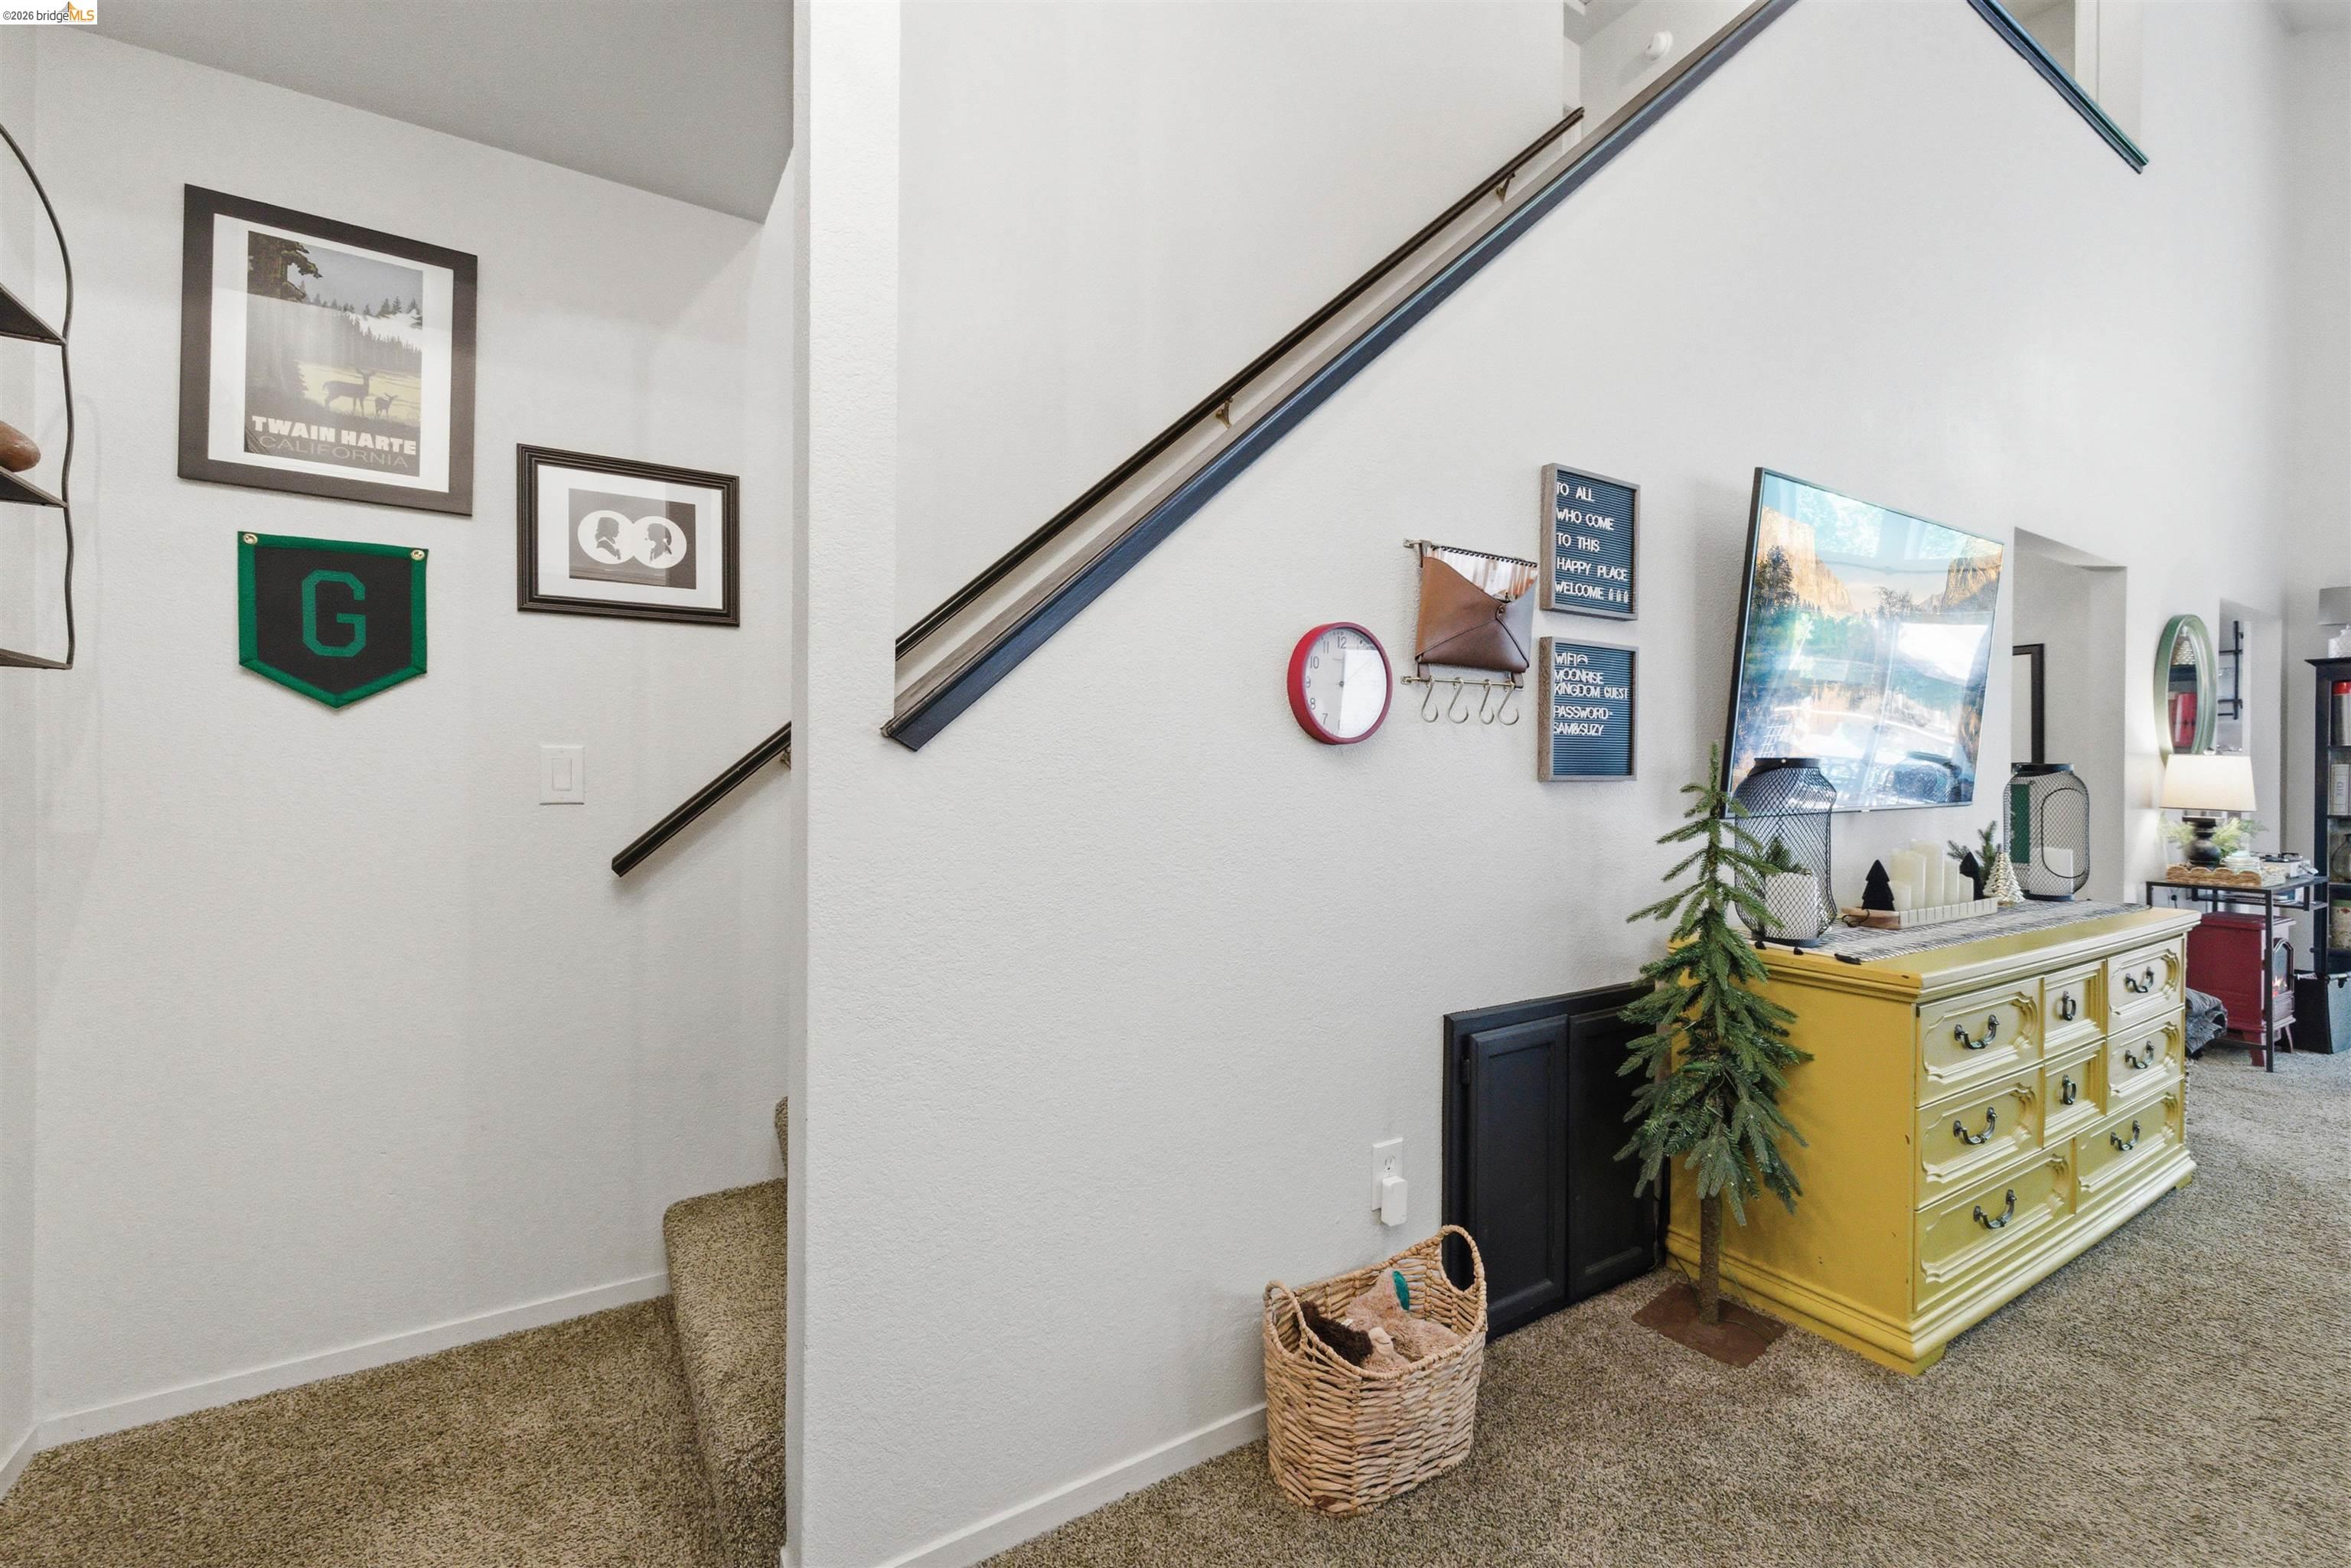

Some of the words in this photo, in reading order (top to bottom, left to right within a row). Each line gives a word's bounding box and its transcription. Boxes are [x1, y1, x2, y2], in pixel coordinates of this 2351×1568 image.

[252, 416, 336, 442] TWAIN
[341, 429, 416, 455] HARTE
[258, 435, 408, 468] CALIFORNIA
[1556, 482, 1569, 496] TO
[1576, 487, 1596, 501] ALL
[1556, 507, 1582, 523] WHO
[1586, 513, 1615, 530] COME
[1556, 533, 1571, 548] TO
[1577, 536, 1600, 553] THIS
[1557, 557, 1592, 575] HAPPY
[1597, 565, 1629, 582] PLACE
[1555, 581, 1604, 600] WELCOME
[302, 569, 367, 657] G
[1322, 641, 1329, 654] 11
[1337, 636, 1347, 649] 12
[1310, 656, 1319, 669] 10
[1554, 668, 1604, 685] MOONRISE
[1554, 682, 1600, 698] KINGDOM
[1604, 686, 1629, 699] GUEST
[1310, 697, 1316, 710] 8
[1322, 712, 1329, 725] 7
[1554, 722, 1604, 736] SAM&SUZY
